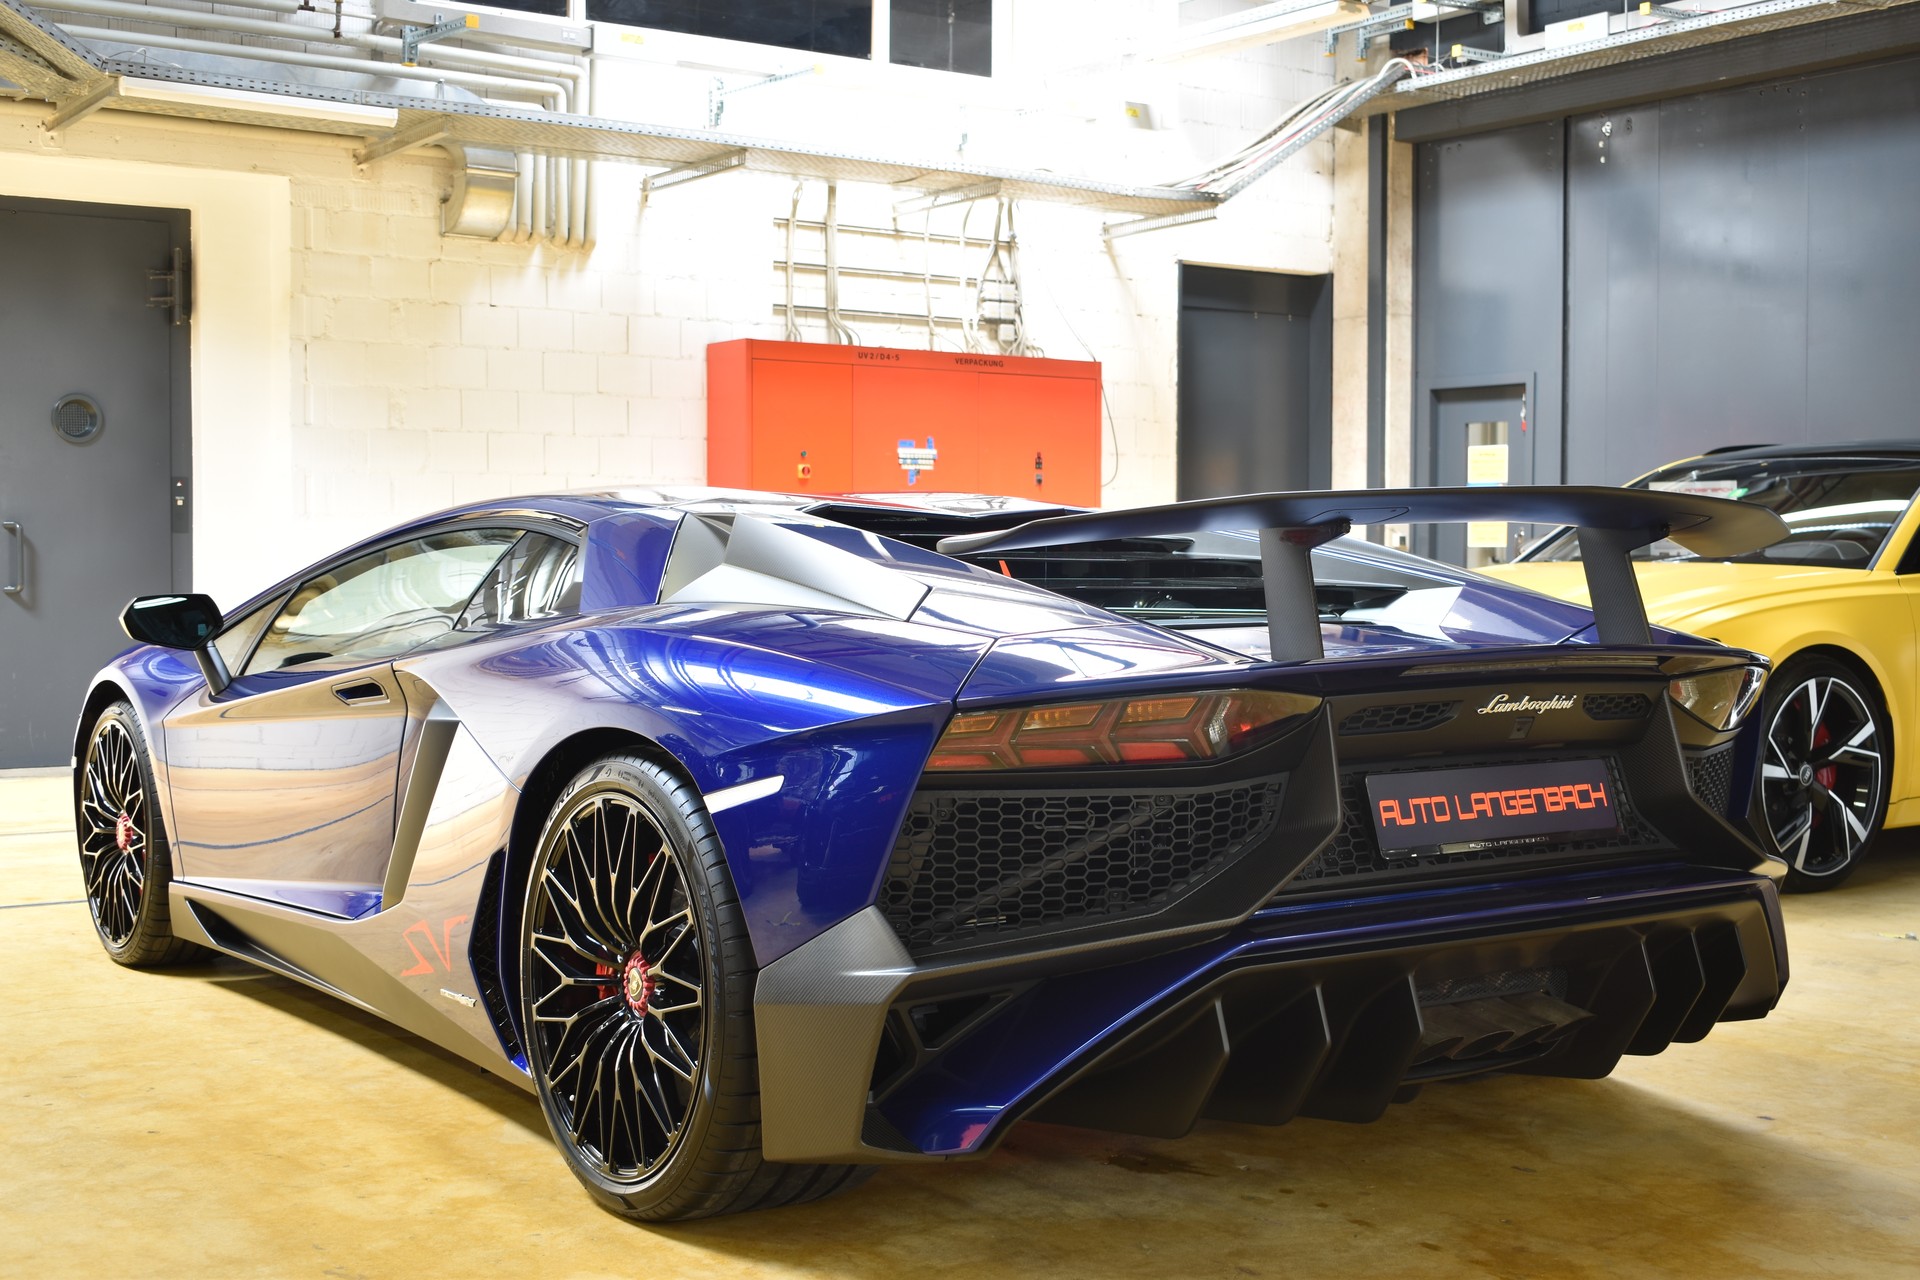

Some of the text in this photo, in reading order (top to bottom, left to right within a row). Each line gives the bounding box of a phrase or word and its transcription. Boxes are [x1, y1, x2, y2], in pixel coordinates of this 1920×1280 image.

[955, 357, 1004, 368] VERPACKUNG
[1477, 693, 1577, 715] Lamborghini
[1379, 782, 1608, 827] AUTO LANGENBACH
[1468, 841, 1492, 849] AUTO
